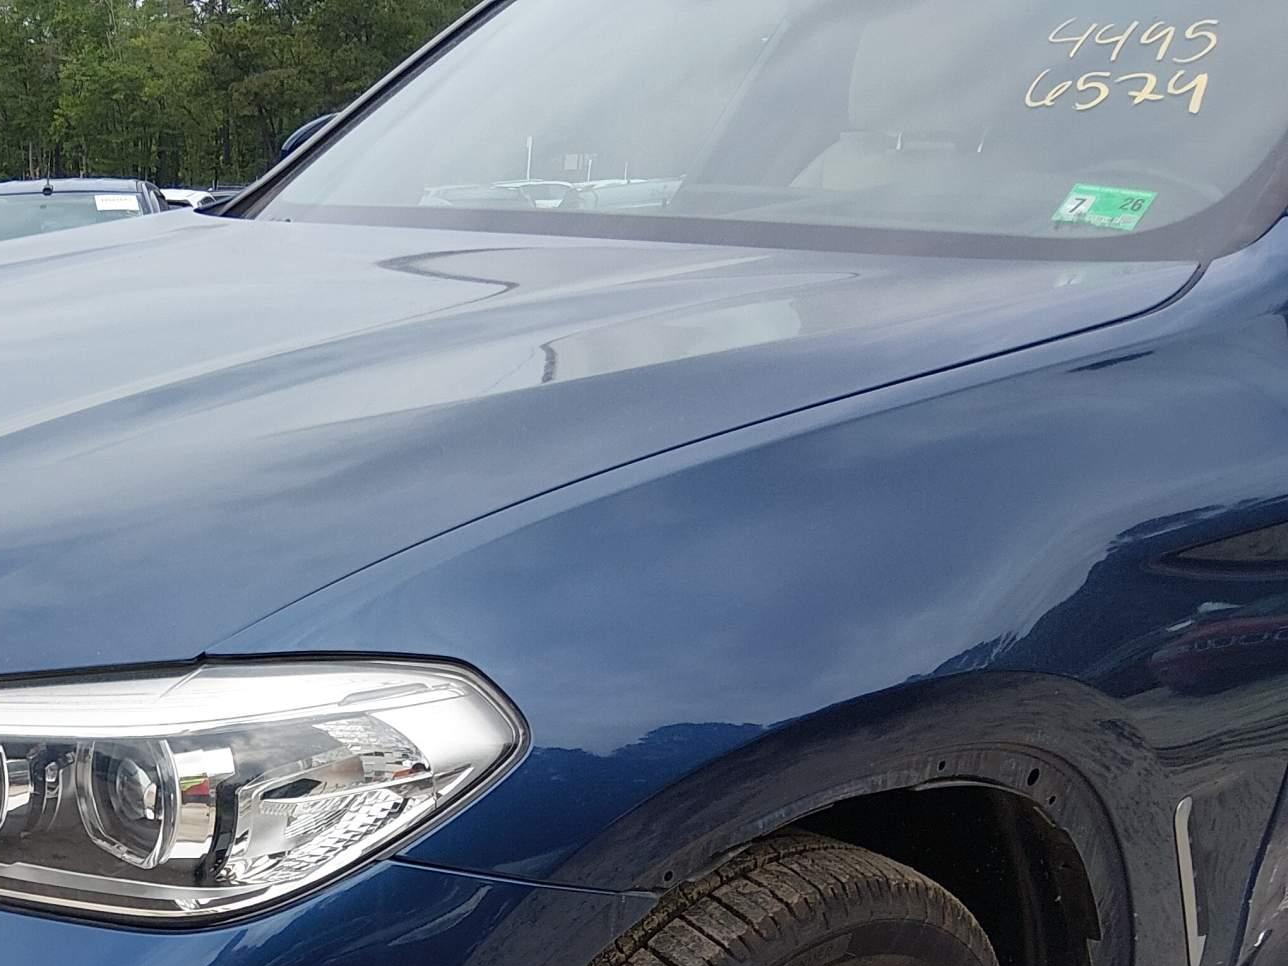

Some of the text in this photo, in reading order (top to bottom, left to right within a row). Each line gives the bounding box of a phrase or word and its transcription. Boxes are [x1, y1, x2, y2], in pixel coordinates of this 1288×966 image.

[1048, 16, 1219, 64] 4495
[1068, 197, 1146, 214] 7 26
